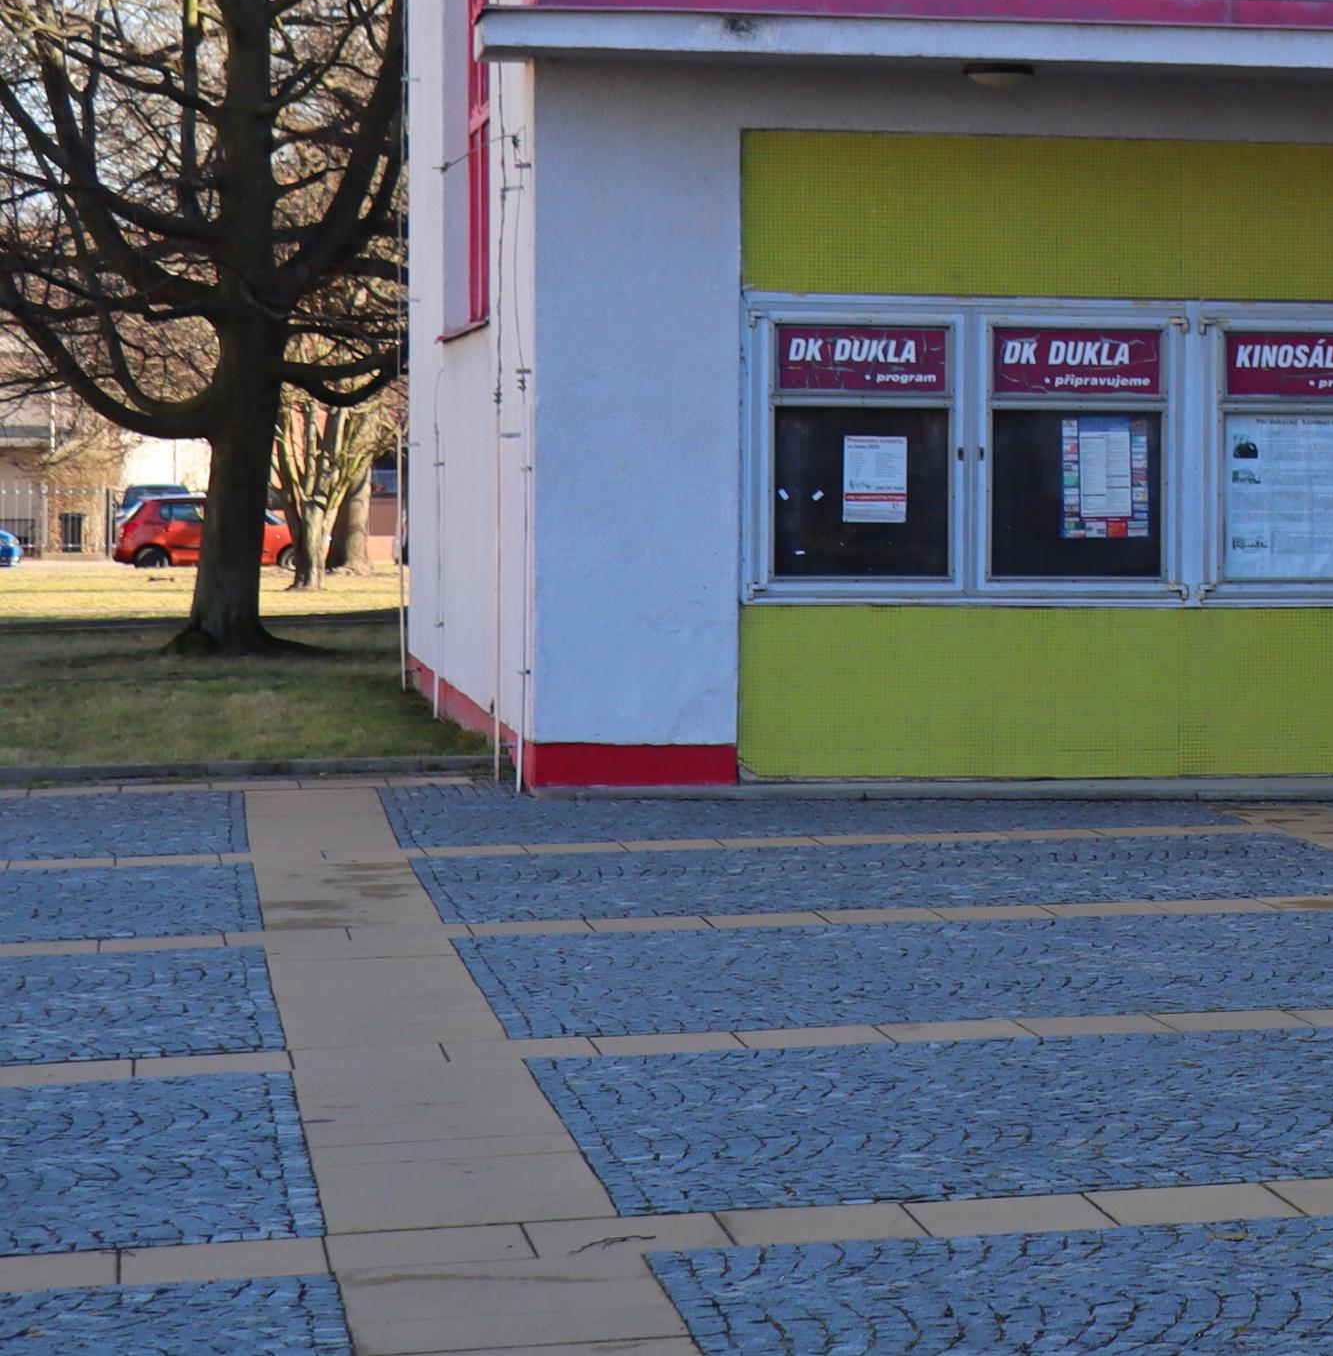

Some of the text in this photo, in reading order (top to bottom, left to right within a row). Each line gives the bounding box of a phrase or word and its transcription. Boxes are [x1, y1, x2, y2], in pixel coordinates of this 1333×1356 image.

[788, 336, 917, 364] DK DUKLA
[1003, 339, 1131, 366] DK DUKLA
[876, 372, 938, 385] program
[1054, 372, 1151, 388] připravujeme
